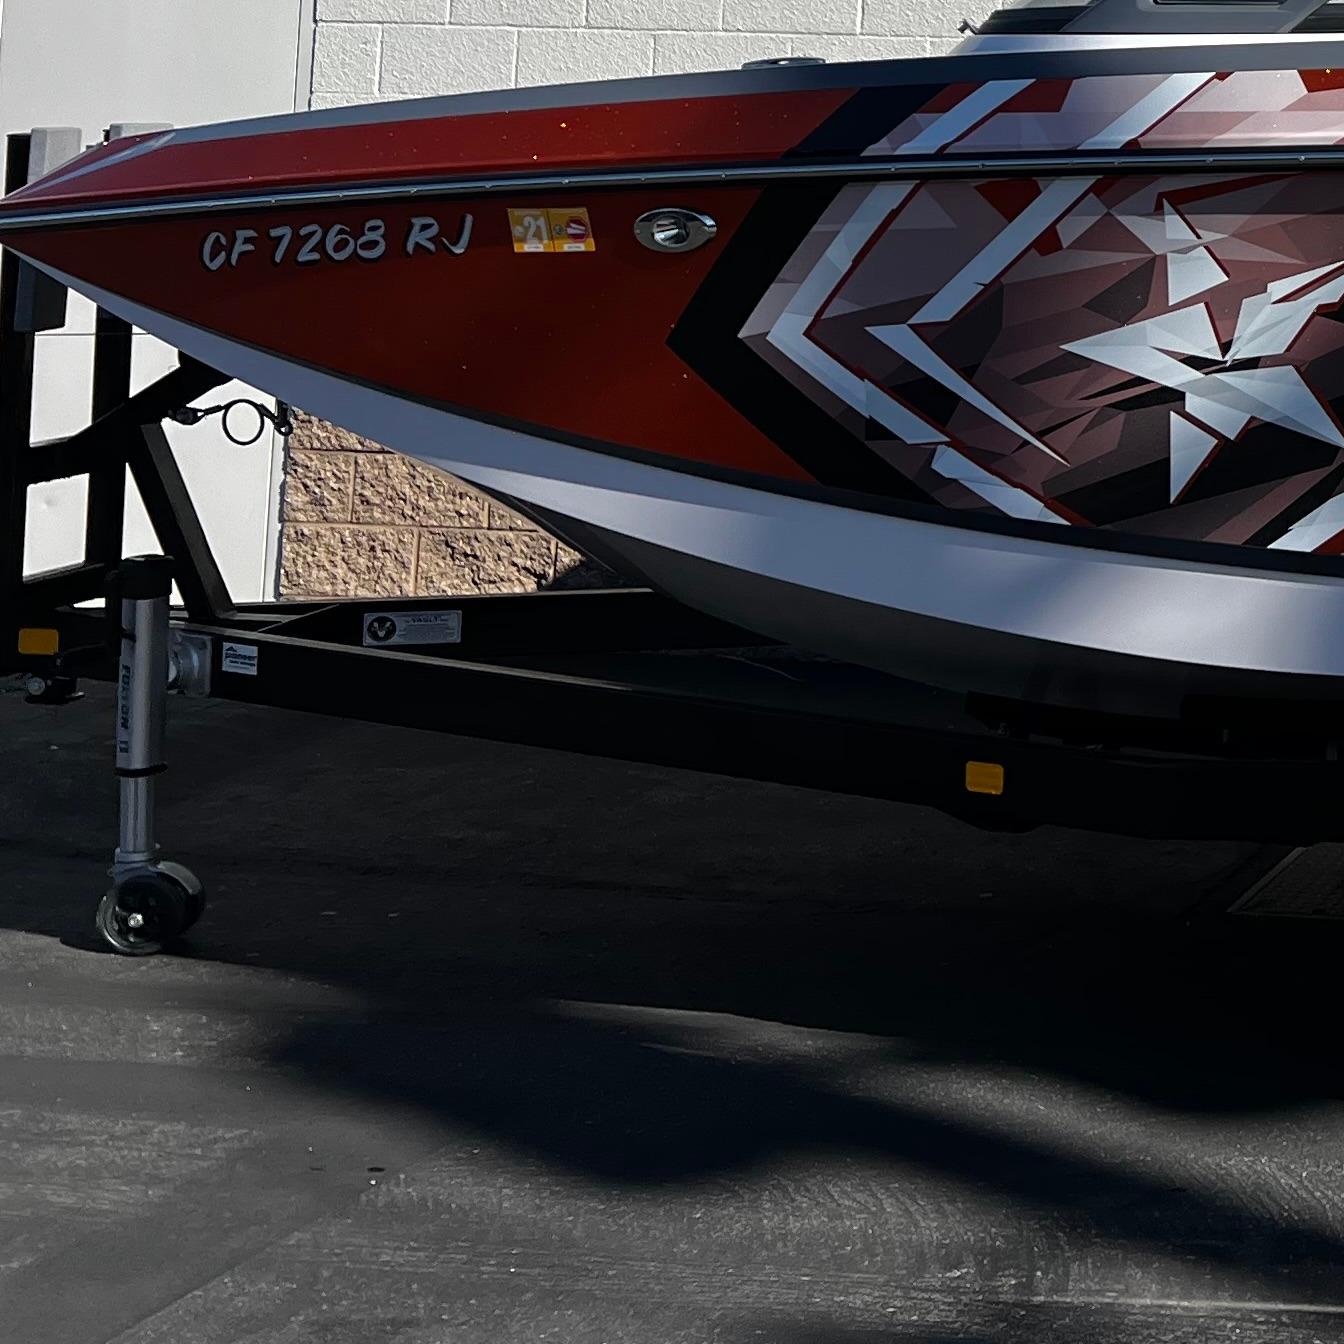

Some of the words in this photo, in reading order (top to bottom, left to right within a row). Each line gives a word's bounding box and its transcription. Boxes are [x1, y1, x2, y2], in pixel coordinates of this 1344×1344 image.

[202, 228, 256, 272] CF
[269, 217, 388, 264] 7268
[406, 212, 474, 256] RJ
